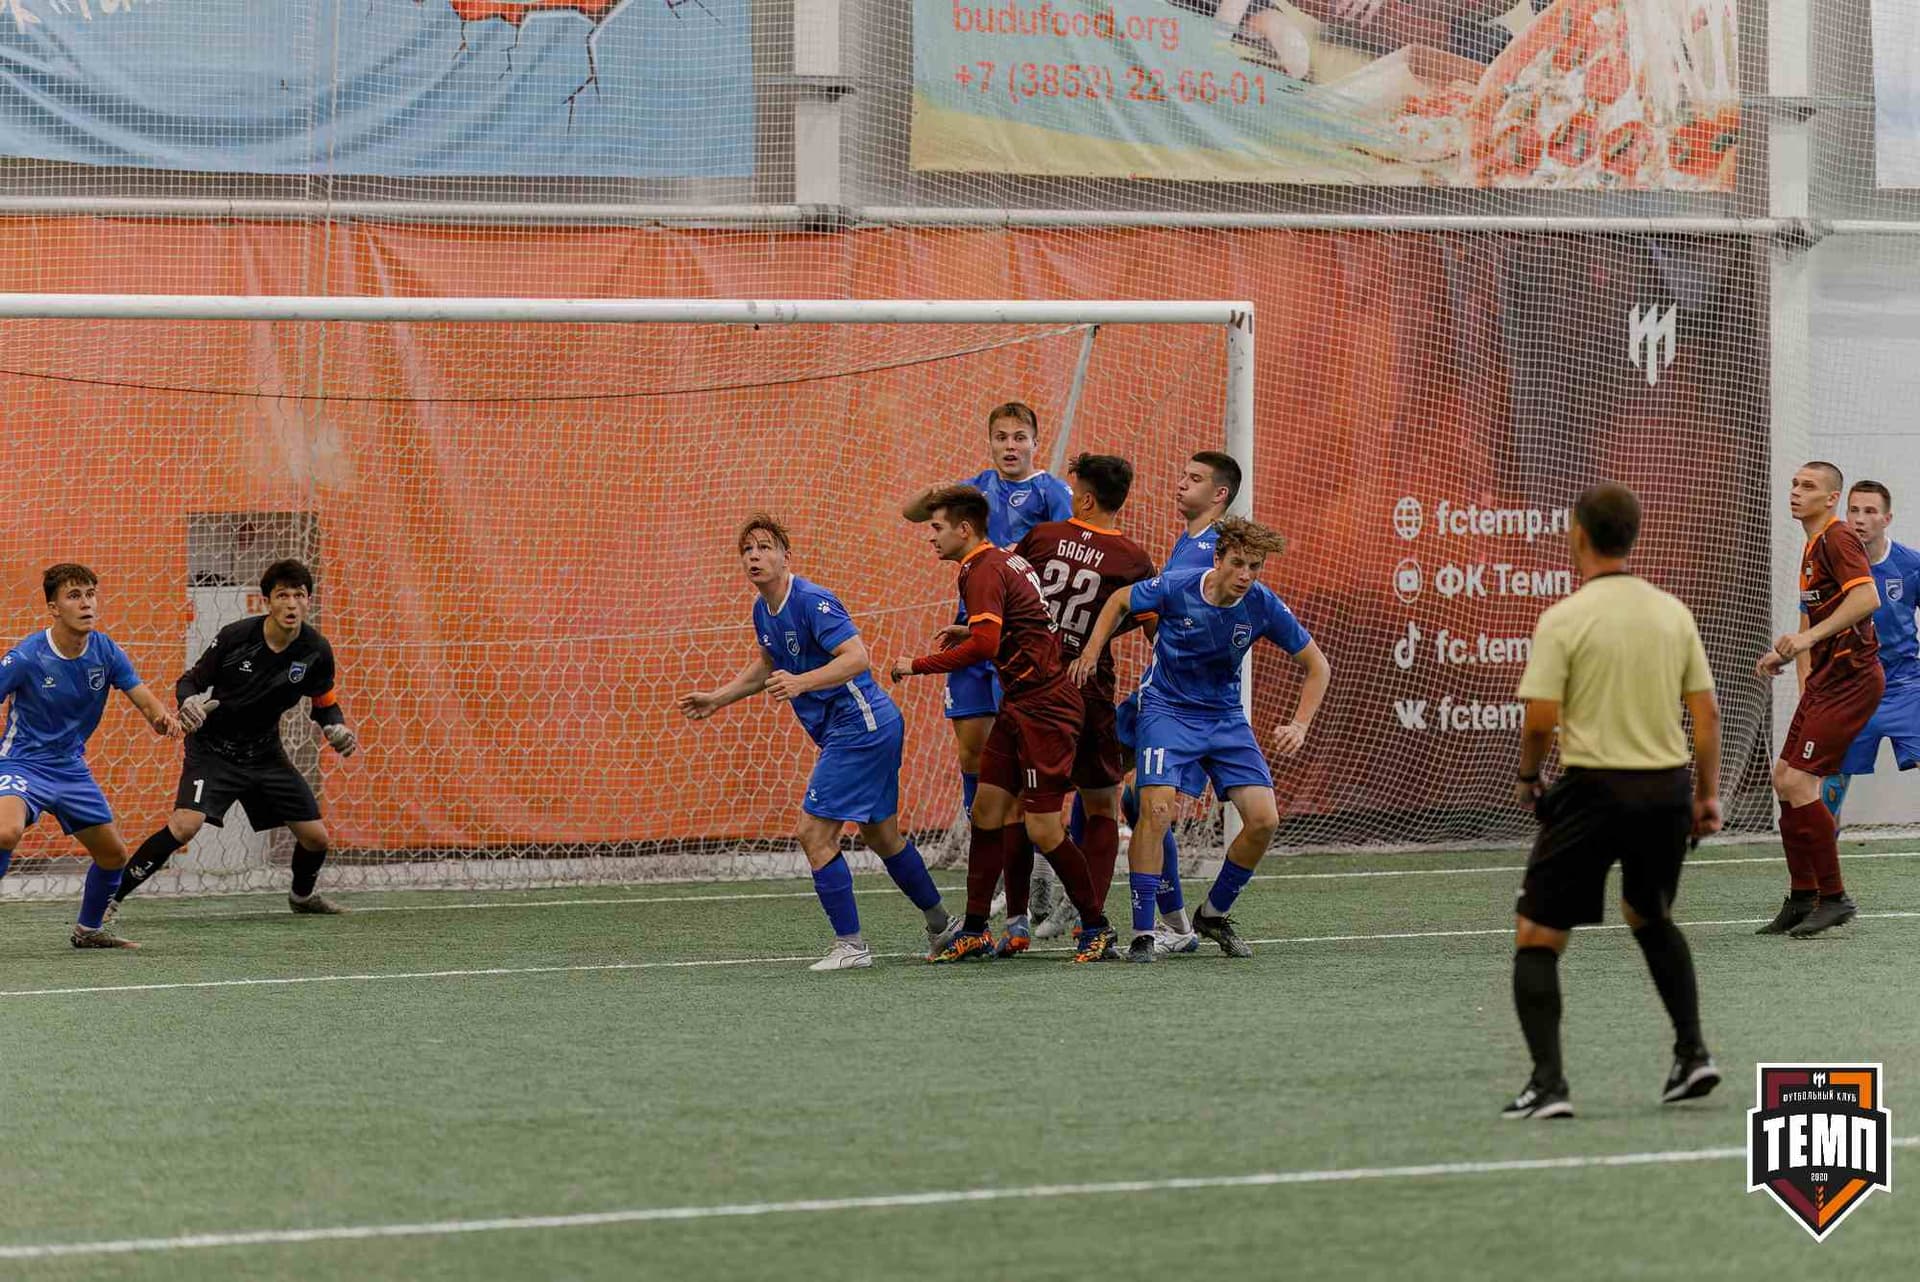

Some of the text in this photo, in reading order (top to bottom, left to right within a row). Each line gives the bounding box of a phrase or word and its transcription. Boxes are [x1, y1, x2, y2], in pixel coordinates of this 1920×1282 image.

[952, 0, 1180, 51] budufood.org
[954, 61, 1266, 106] +7 (3852) 22-66-01
[1056, 539, 1105, 568] БАБИЧ
[1435, 562, 1571, 599] ФК Темп
[1043, 559, 1101, 634] 22
[1143, 746, 1165, 776] 11
[1802, 740, 1816, 760] 9
[0, 774, 29, 793] 23
[192, 779, 205, 804] 1
[1026, 767, 1038, 789] 11
